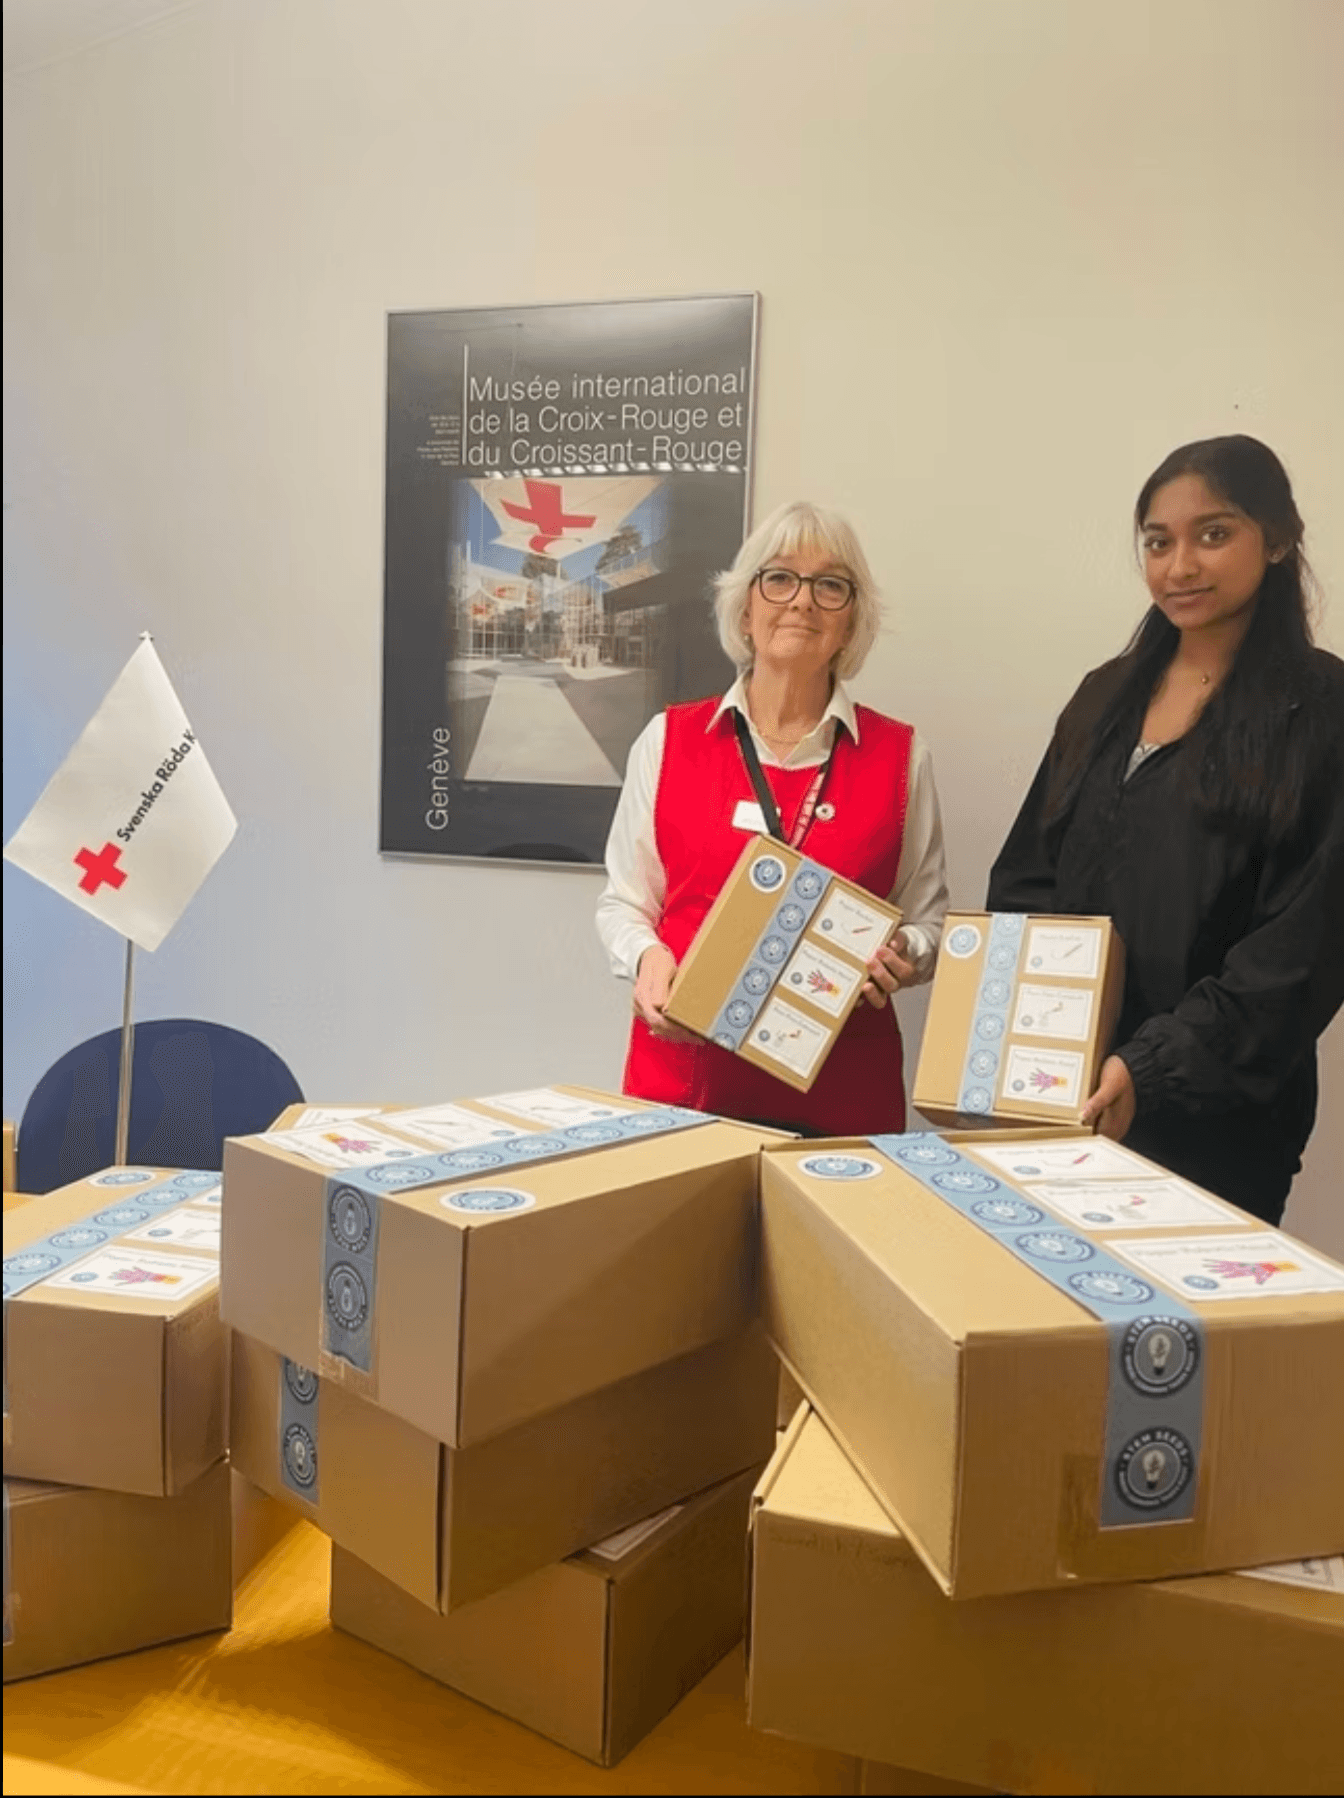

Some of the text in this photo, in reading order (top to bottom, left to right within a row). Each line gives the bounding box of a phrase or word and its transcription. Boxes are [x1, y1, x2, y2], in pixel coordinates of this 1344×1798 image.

[469, 367, 746, 402] Musée international
[469, 409, 501, 434] de
[509, 407, 530, 433] la
[538, 403, 708, 434] Croix-Rouge
[717, 403, 743, 428] et
[468, 441, 501, 466] du
[510, 435, 743, 466] Croissant-Rouge
[116, 780, 164, 842] Svenska
[155, 742, 192, 782] Röda
[425, 727, 451, 830] Genève
